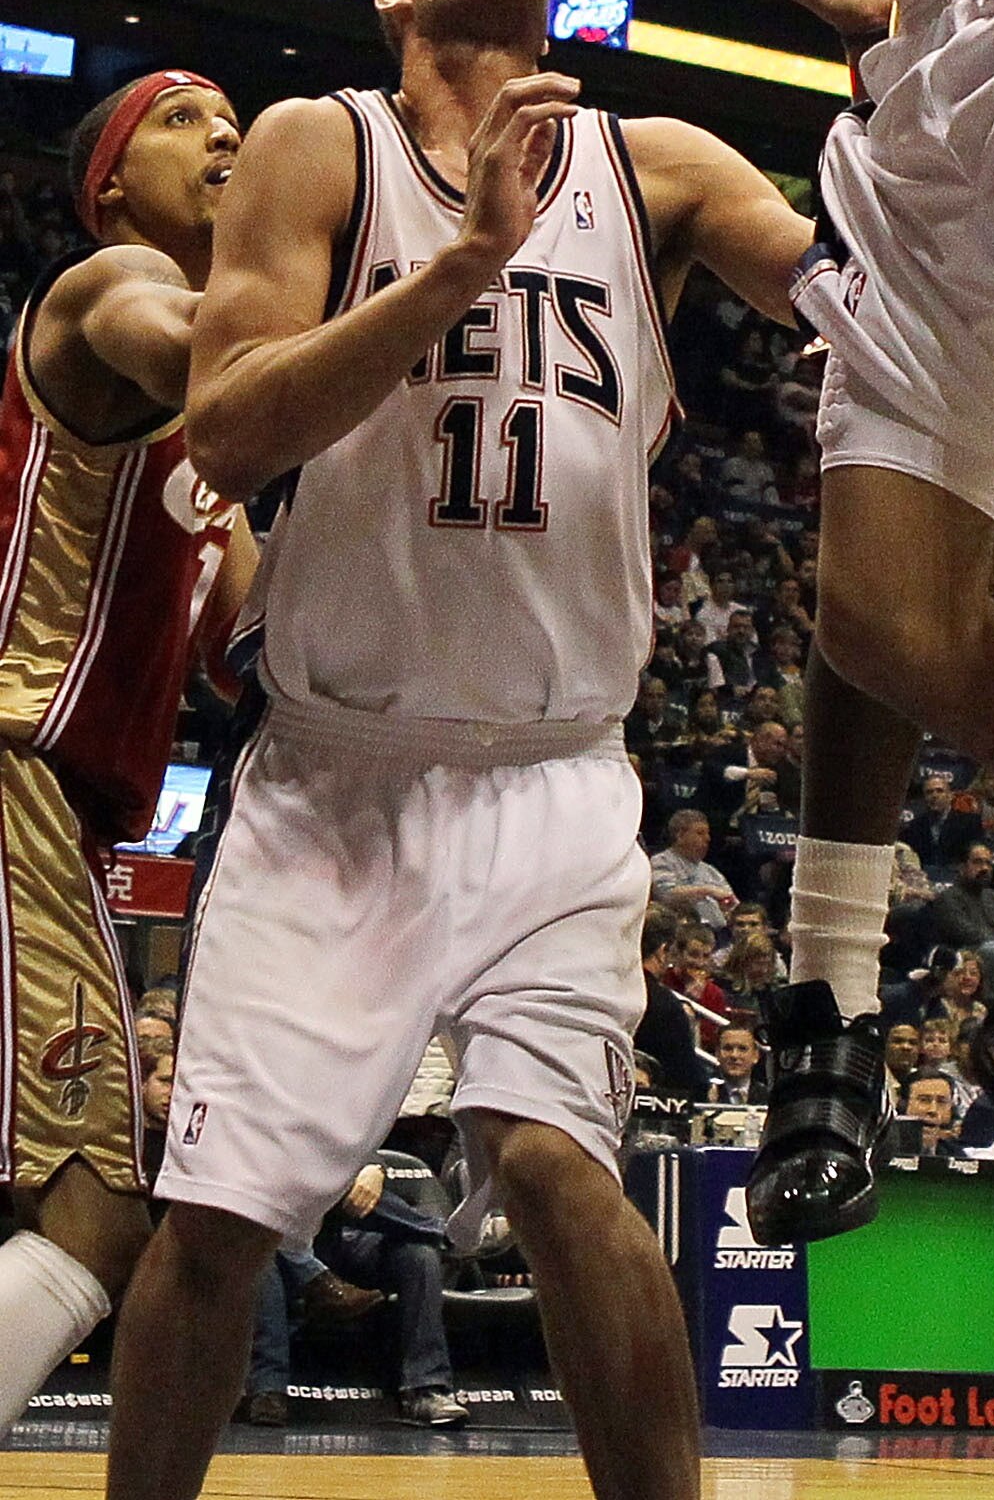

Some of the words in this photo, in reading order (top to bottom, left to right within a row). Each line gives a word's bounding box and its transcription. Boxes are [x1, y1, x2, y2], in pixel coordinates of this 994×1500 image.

[428, 395, 550, 532] 11
[714, 1250, 795, 1269] STARTER
[718, 1368, 800, 1388] STARTER
[879, 1383, 956, 1426] Foot
